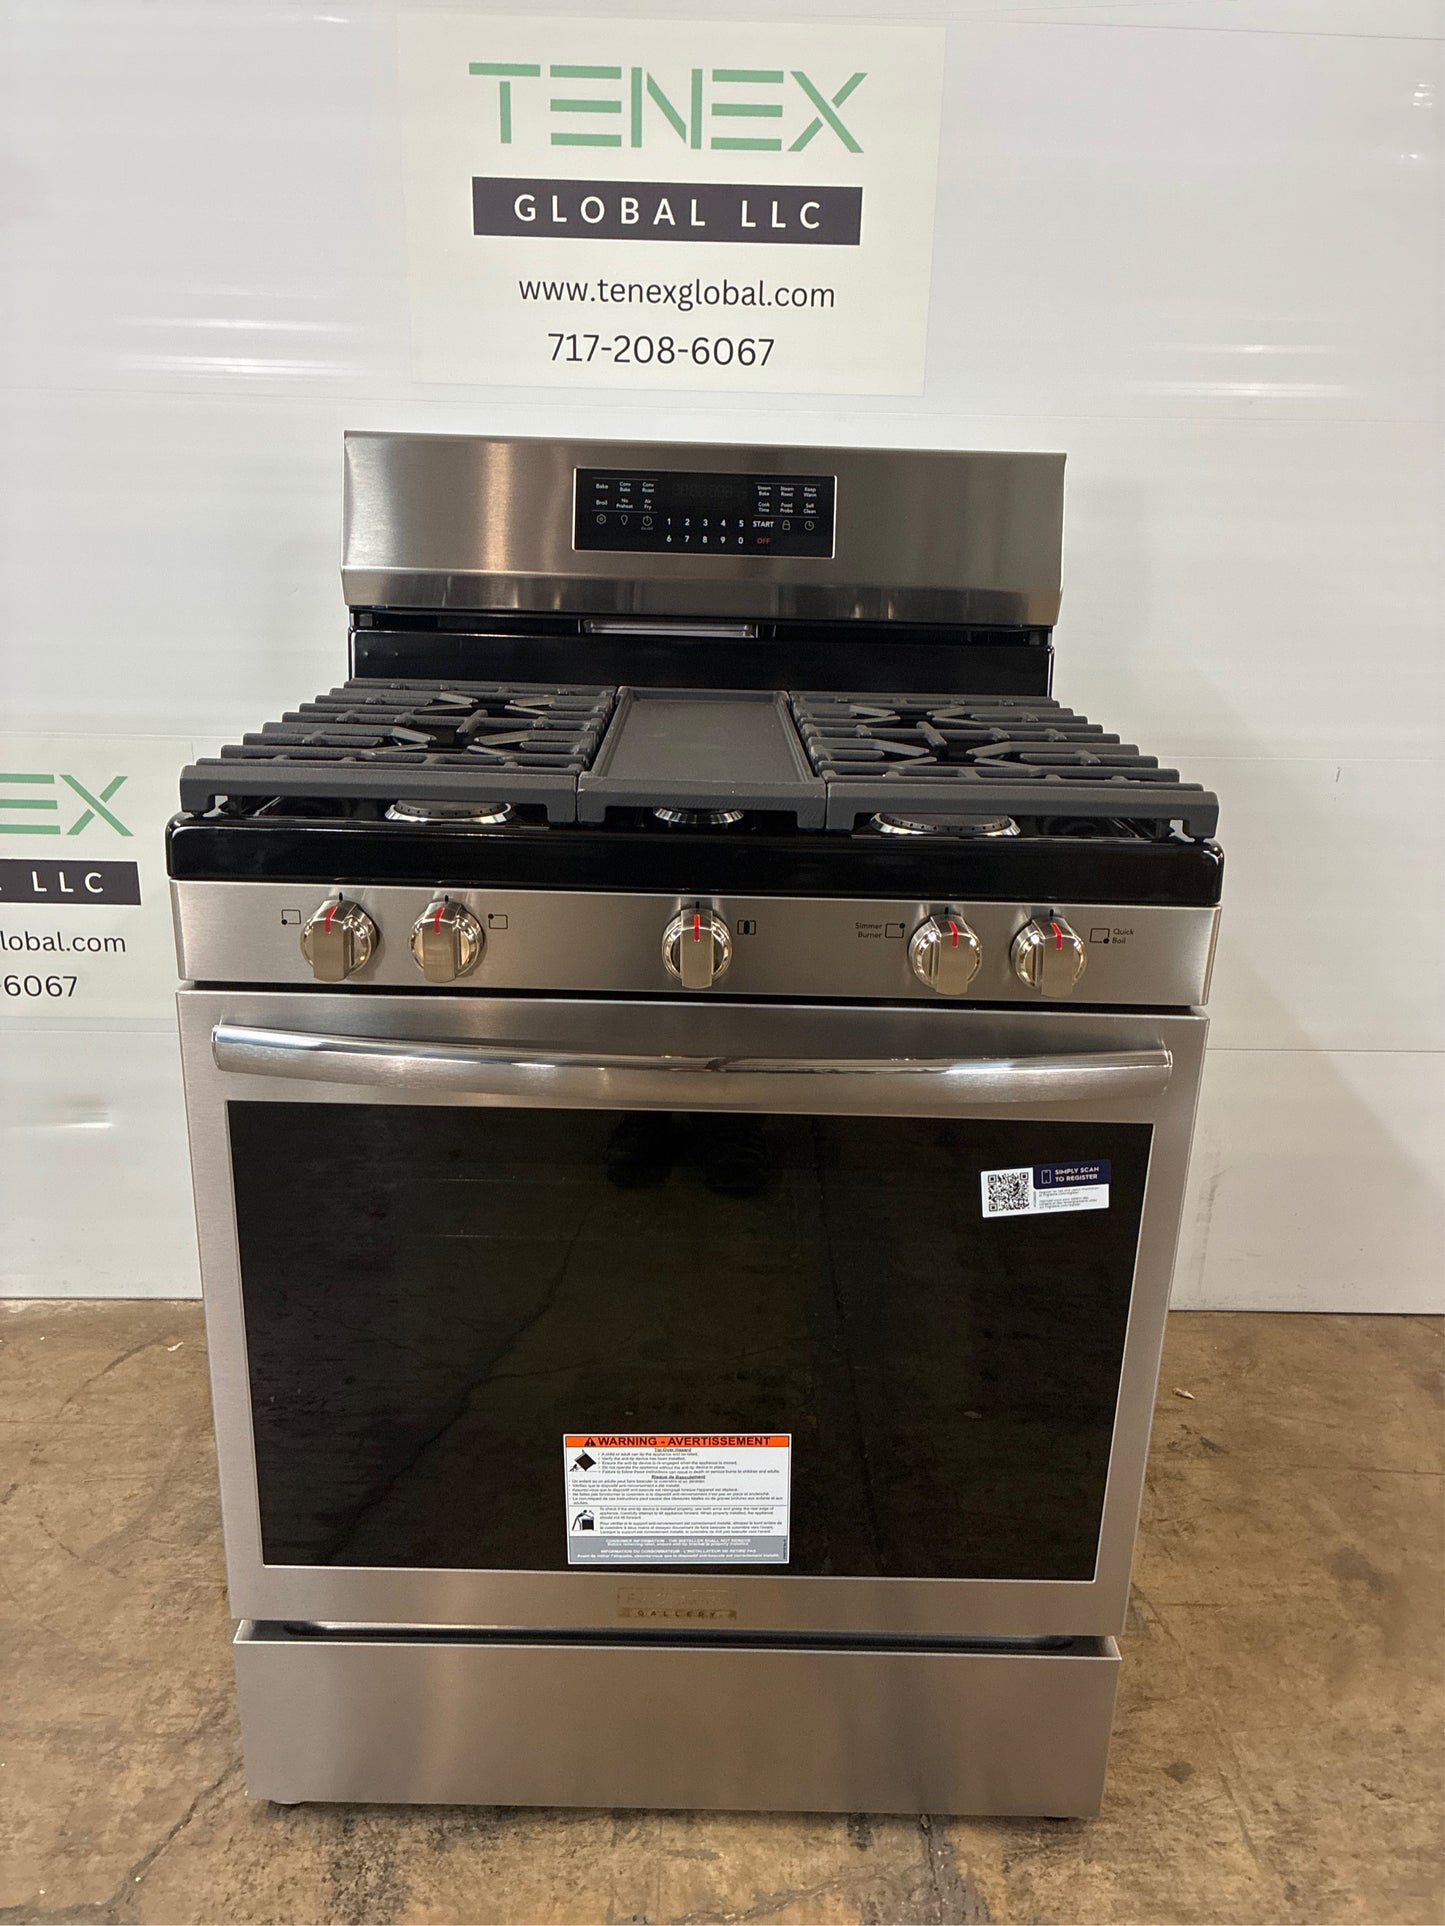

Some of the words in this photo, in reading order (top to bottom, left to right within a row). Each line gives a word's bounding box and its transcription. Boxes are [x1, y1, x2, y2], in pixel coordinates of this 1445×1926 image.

[469, 62, 868, 153] TENEX
[514, 194, 706, 226] GLOBAL
[740, 200, 821, 229] LLC
[518, 278, 835, 311] www.tenexglobal.com
[547, 333, 775, 366] 717-208-6067
[684, 518, 690, 526] 2
[702, 518, 708, 526] 3
[739, 520, 744, 528] 5
[702, 536, 708, 544] 8
[720, 536, 726, 544] 9
[738, 536, 744, 544] 0
[31, 870, 104, 893] LLC
[0, 930, 126, 953] lobal.com
[0, 974, 78, 997] 6067
[598, 1437, 657, 1446] WARNING
[668, 1437, 770, 1446] AVERTISSEMENT
